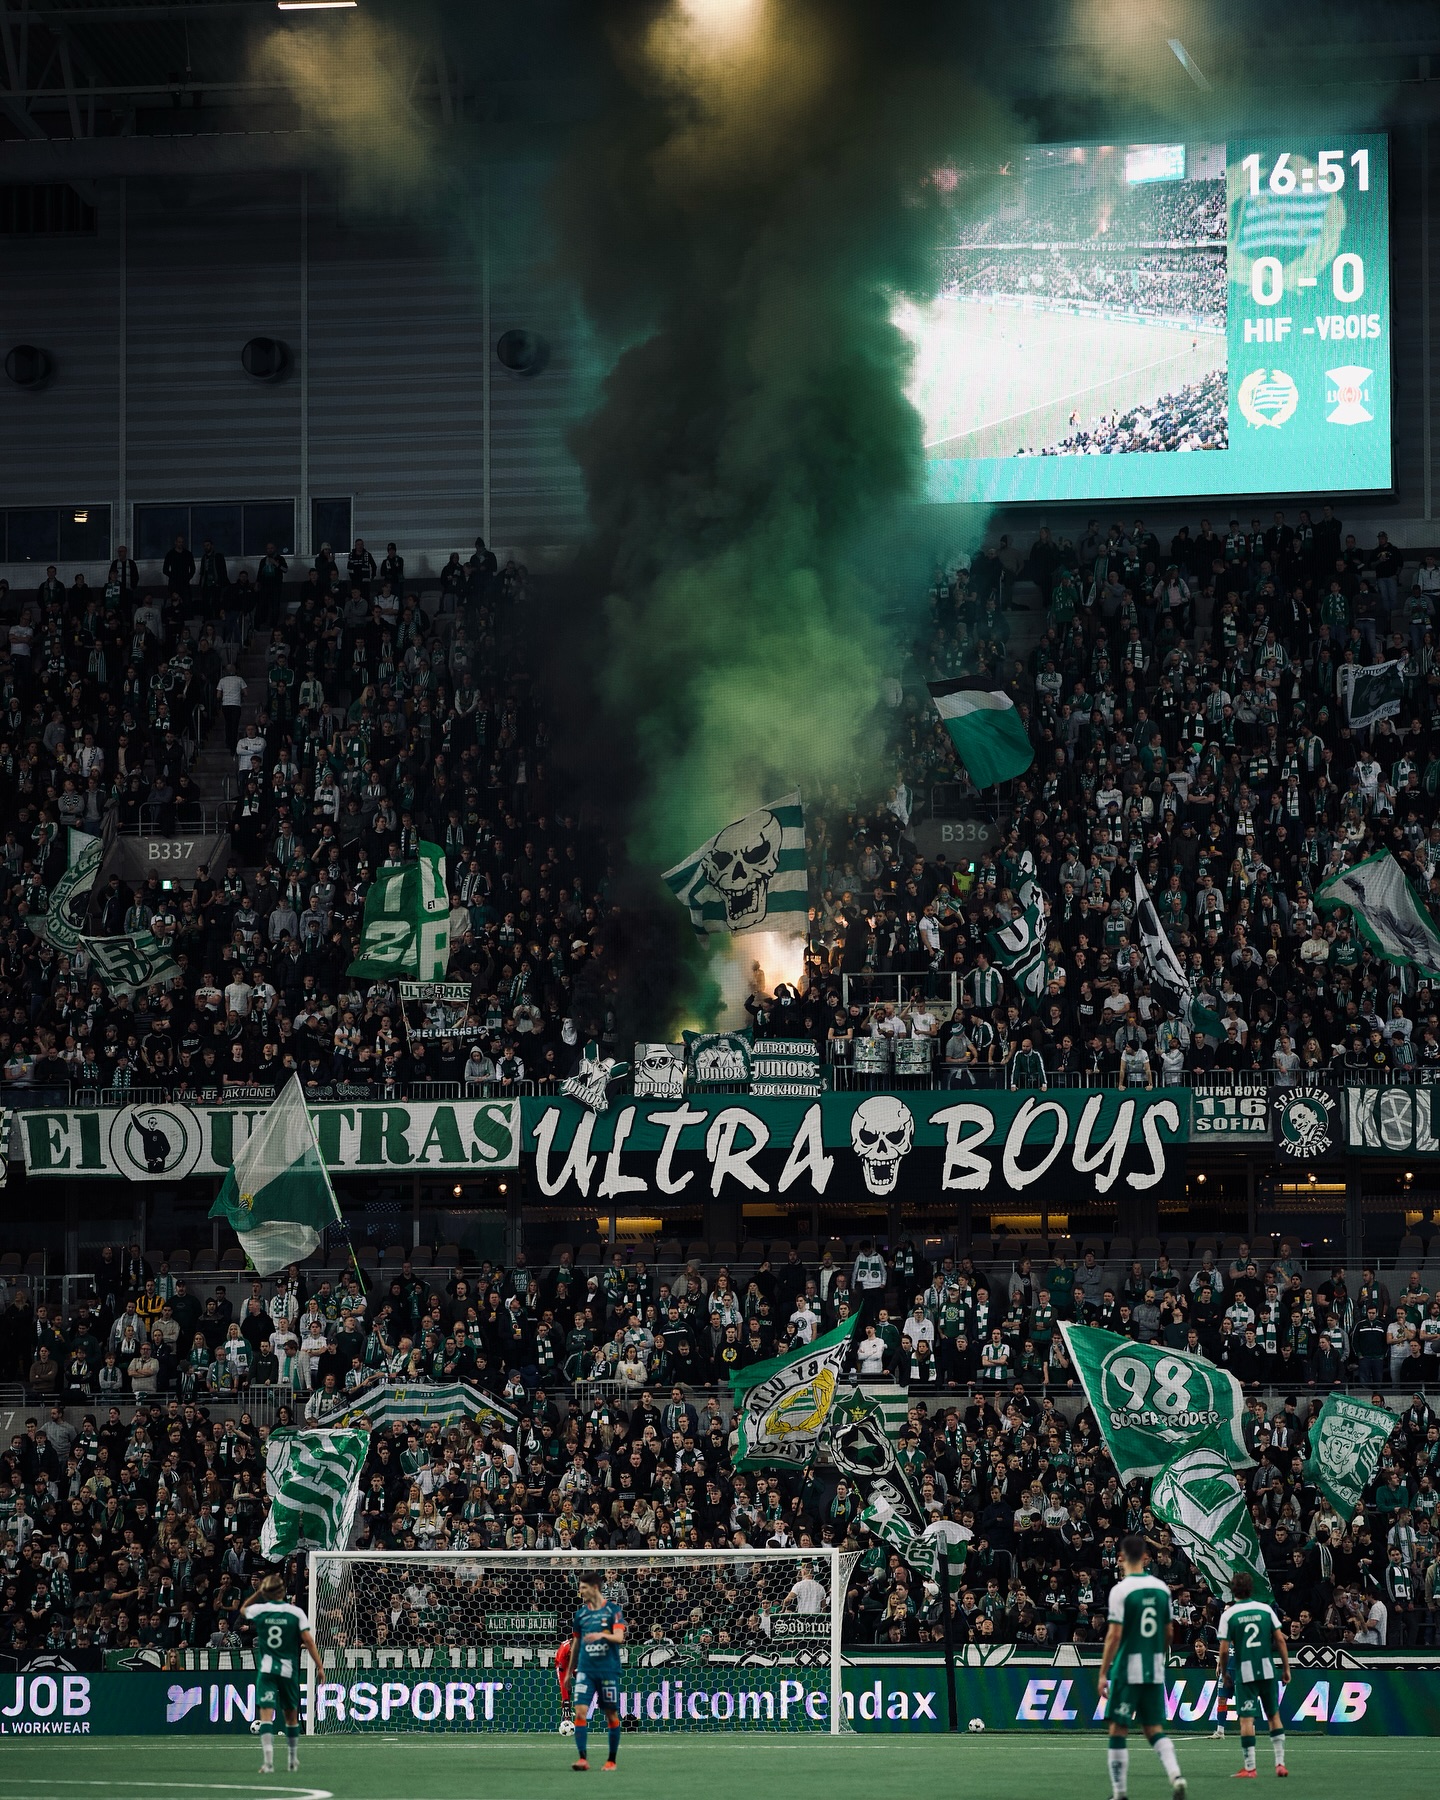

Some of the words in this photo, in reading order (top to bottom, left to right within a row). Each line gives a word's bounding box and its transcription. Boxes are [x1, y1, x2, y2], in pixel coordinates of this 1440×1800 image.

[1242, 149, 1369, 196] 16:51
[1251, 256, 1283, 305] 0
[1332, 253, 1364, 303] 0
[1244, 317, 1292, 343] HIF
[941, 824, 989, 842] B336
[148, 842, 195, 860] B337
[435, 1027, 472, 1038] ULTRAS
[753, 1042, 787, 1055] ULTRA
[789, 1043, 817, 1056] BOYS
[695, 1066, 748, 1084] JUNIORS
[752, 1060, 817, 1080] JUNIORS
[561, 1080, 609, 1113] JUNIORS
[635, 1081, 683, 1095] JUNIORS
[752, 1083, 819, 1097] STOCKHOLM
[1195, 1086, 1232, 1097] ULTRA
[1234, 1086, 1267, 1097] BOYS
[1195, 1098, 1267, 1116] 116
[1273, 1087, 1336, 1112] SPJUVERN
[1196, 1117, 1266, 1131] SOFIA
[532, 1102, 834, 1199] ULTRA
[928, 1094, 1180, 1193] BOYS
[1279, 1136, 1333, 1158] FOREVER
[1110, 1356, 1193, 1415] 98
[488, 1618, 508, 1629] ALLT
[774, 1618, 831, 1635] Söderor
[1140, 1607, 1157, 1638] 6
[267, 1625, 283, 1649] 8
[1244, 1623, 1262, 1649] 2
[1, 1675, 91, 1717] JOB
[209, 1682, 504, 1723] INRSPORT
[1015, 1679, 1080, 1720] EL
[1291, 1681, 1373, 1723] AB
[12, 1722, 91, 1734] WORKWEAR
